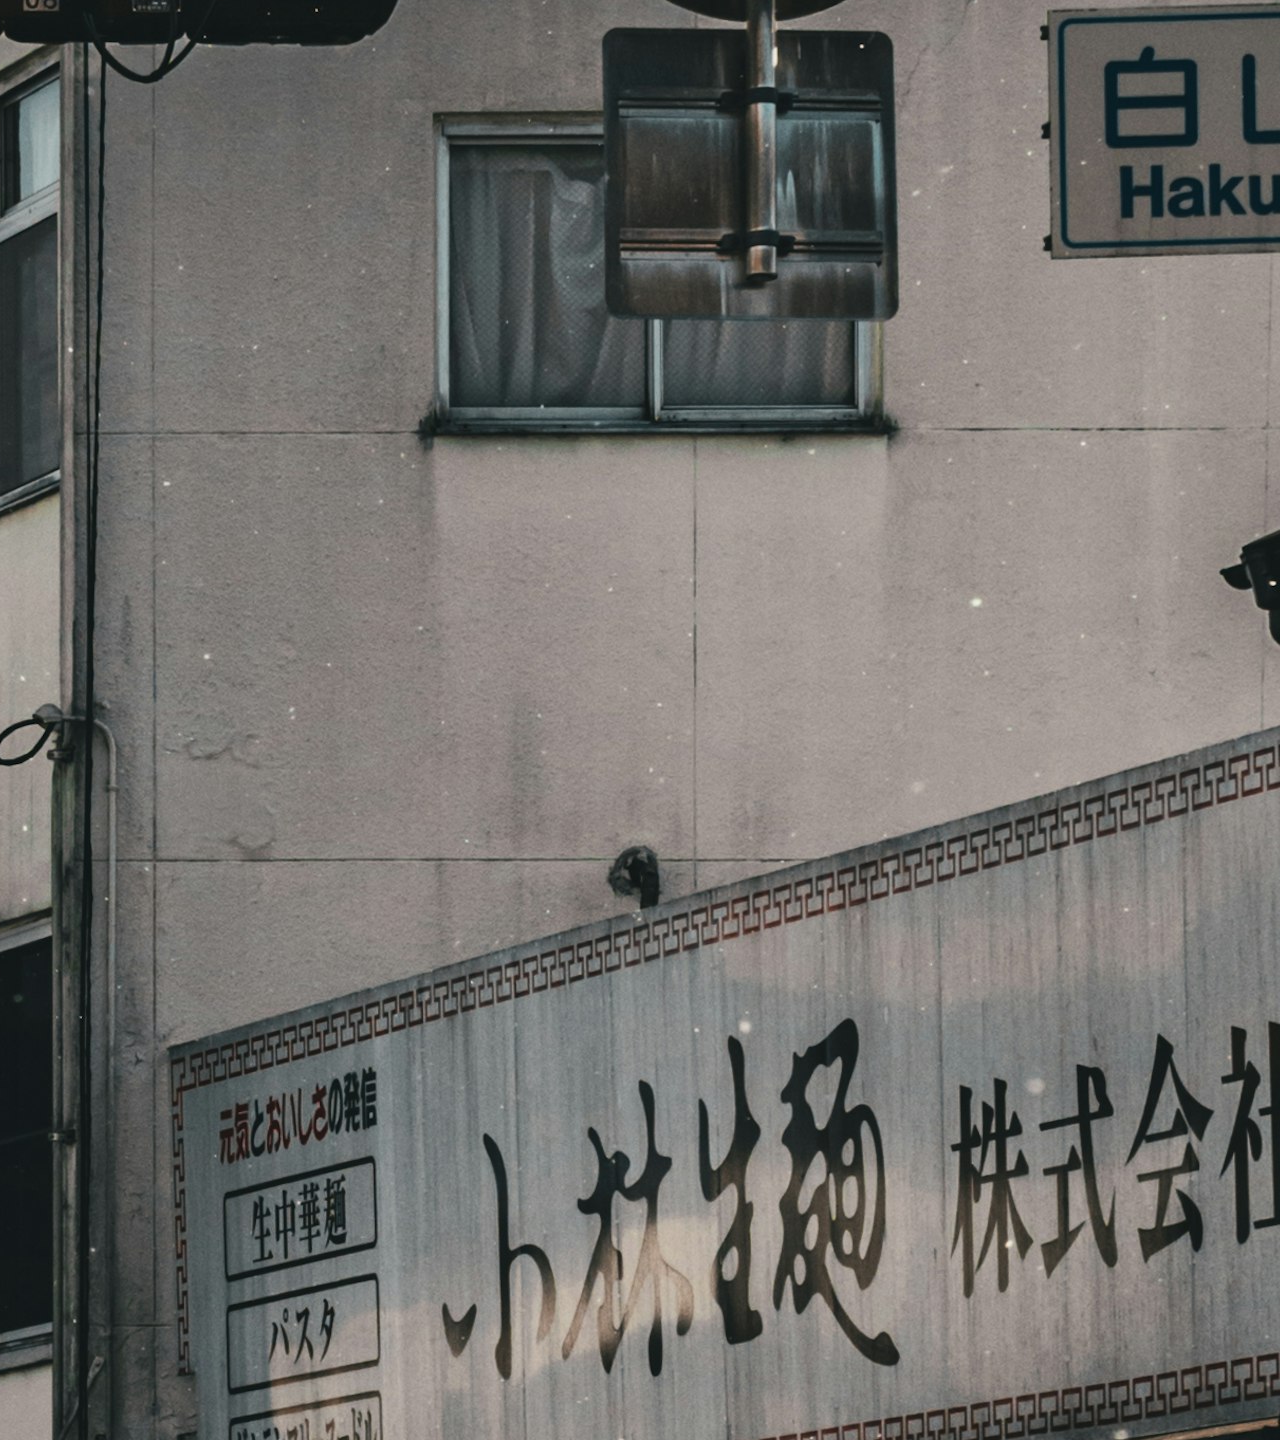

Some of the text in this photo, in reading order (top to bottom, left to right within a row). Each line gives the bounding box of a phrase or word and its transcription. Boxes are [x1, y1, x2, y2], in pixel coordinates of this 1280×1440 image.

[218, 1066, 378, 1165] 元気とおいしさの発信
[269, 1297, 336, 1366] パスタ
